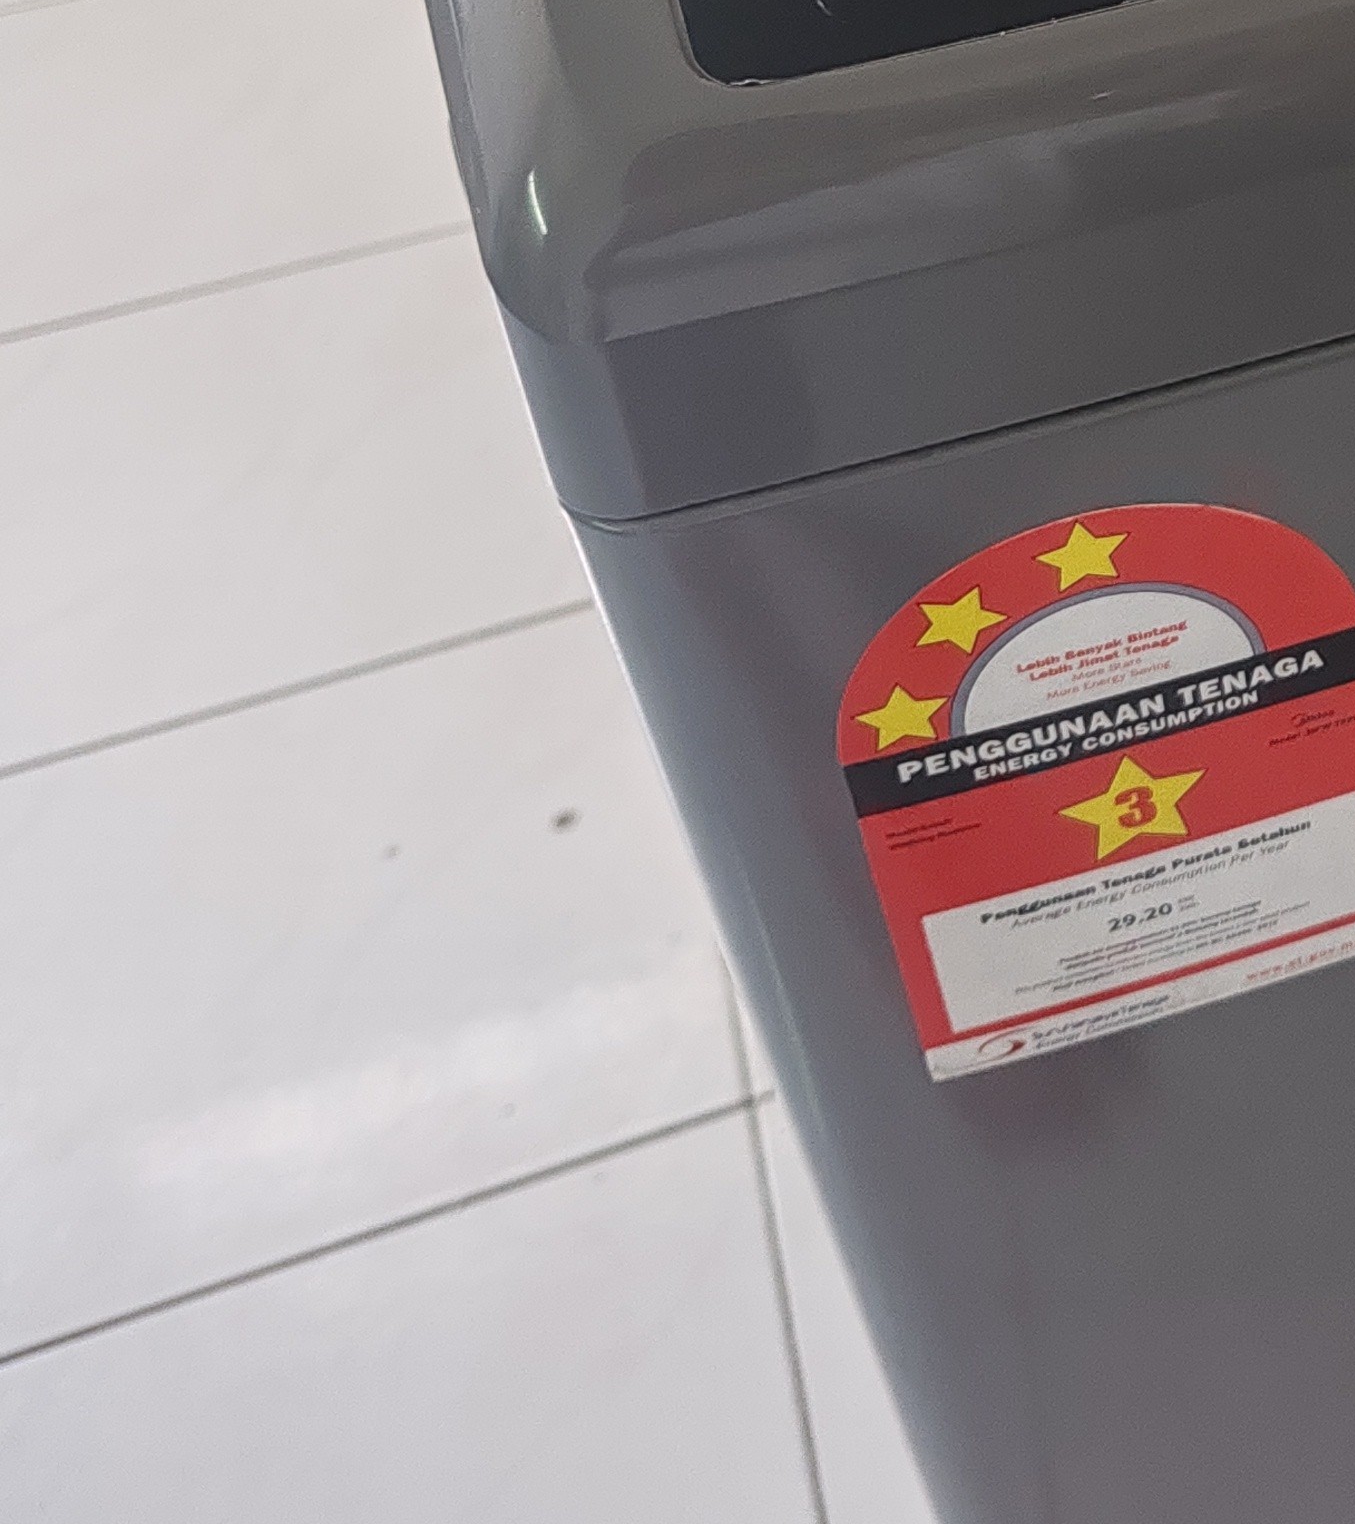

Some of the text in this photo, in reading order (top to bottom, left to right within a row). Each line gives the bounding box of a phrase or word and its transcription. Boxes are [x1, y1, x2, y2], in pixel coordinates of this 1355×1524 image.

[897, 647, 1326, 784] PENGGUNAAN TENAGA
[973, 741, 1073, 782] ENERGY
[1081, 689, 1260, 753] CONSUMPTION
[1114, 786, 1159, 830] 3
[1107, 901, 1175, 935] 29.20
